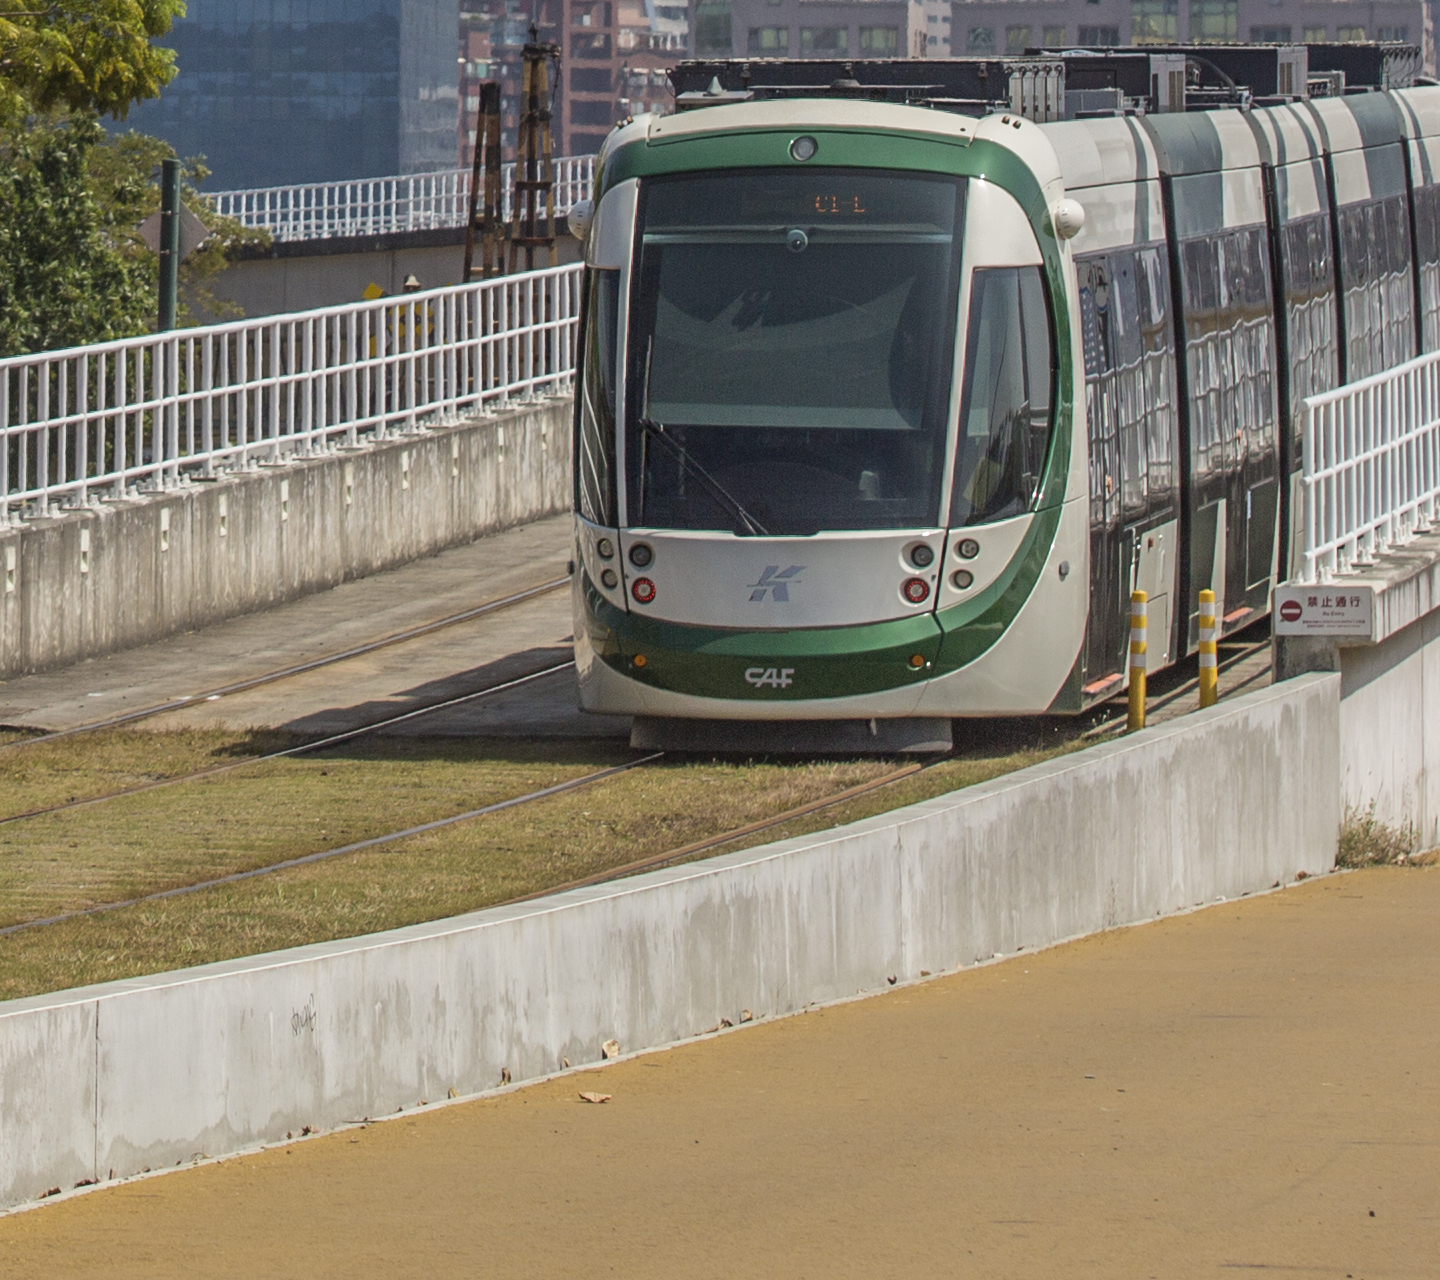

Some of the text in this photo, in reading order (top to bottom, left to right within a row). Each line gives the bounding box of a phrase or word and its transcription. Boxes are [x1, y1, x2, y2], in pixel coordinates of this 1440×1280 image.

[1307, 596, 1360, 608] 禁止通行
[744, 667, 795, 688] CAF
